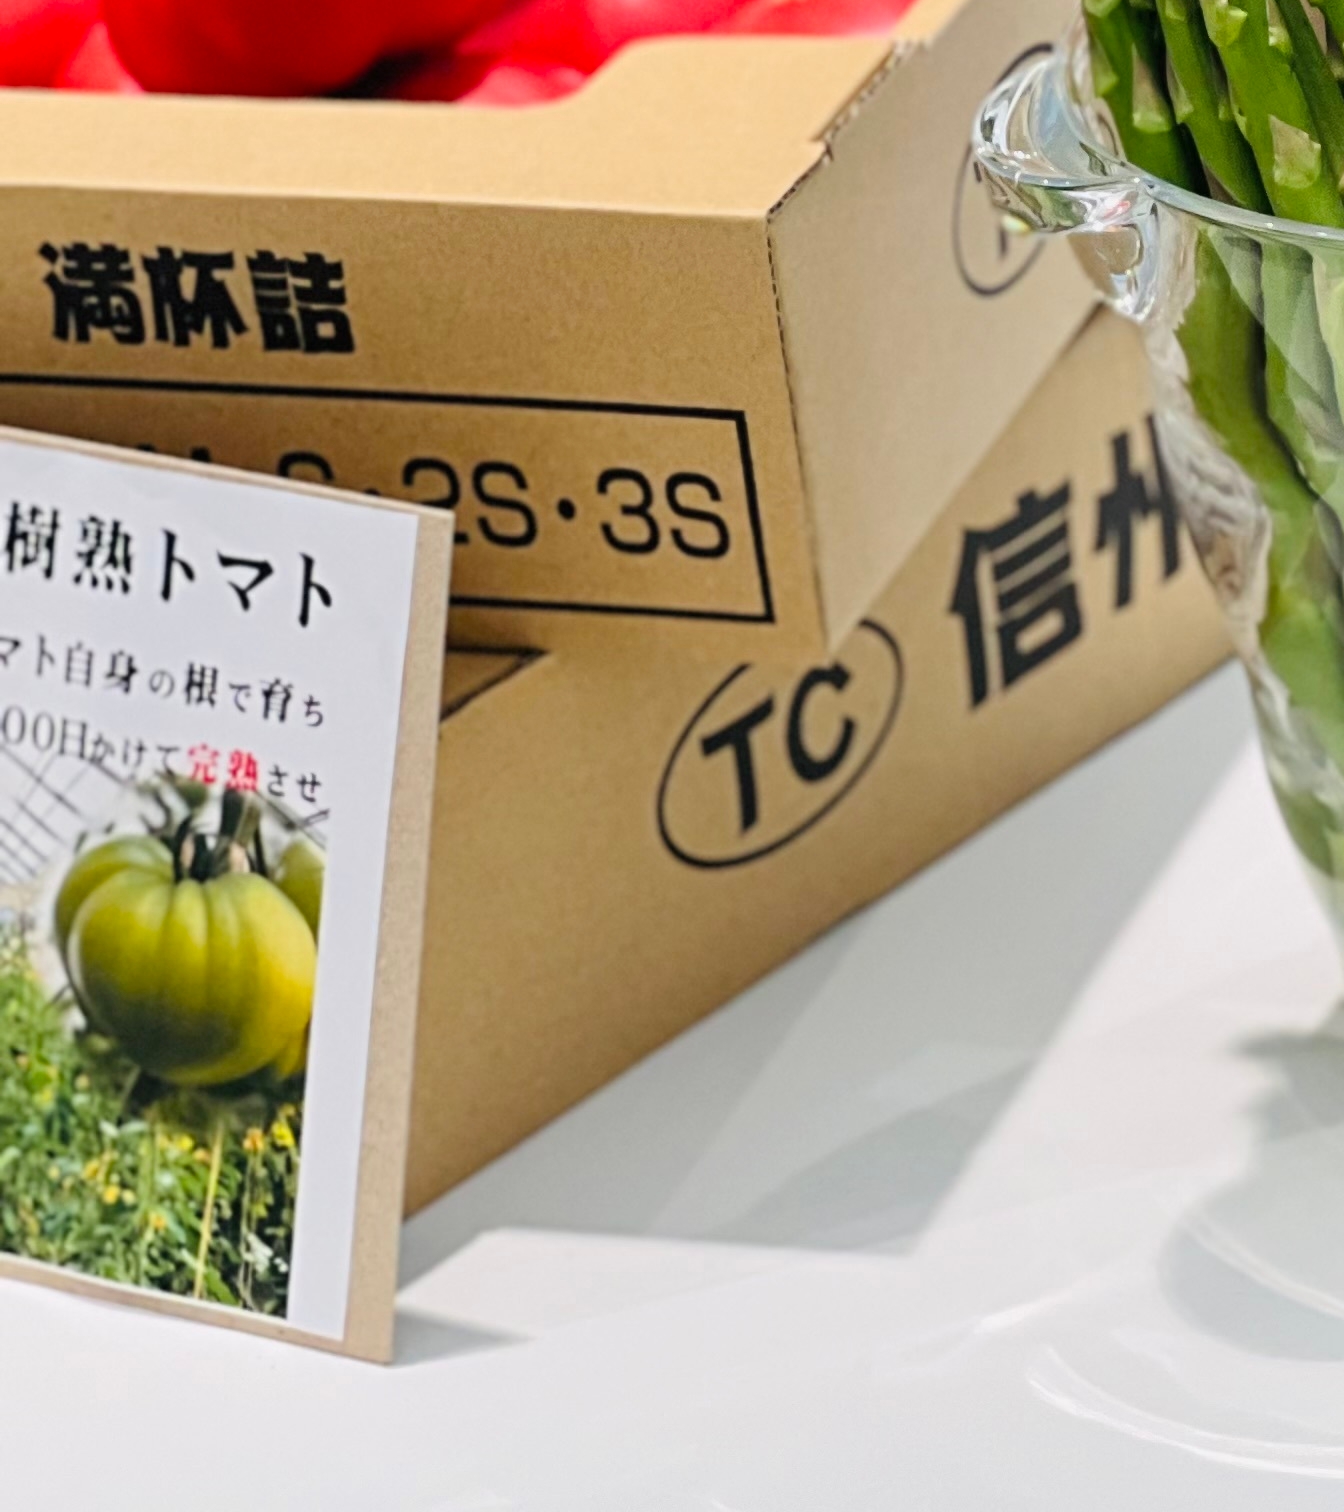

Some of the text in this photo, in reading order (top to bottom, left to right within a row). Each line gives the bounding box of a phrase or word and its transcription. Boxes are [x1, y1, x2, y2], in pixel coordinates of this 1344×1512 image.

[37, 242, 356, 355] 満杯詰
[4, 501, 334, 628] 樹熟トマト
[700, 661, 857, 836] TC
